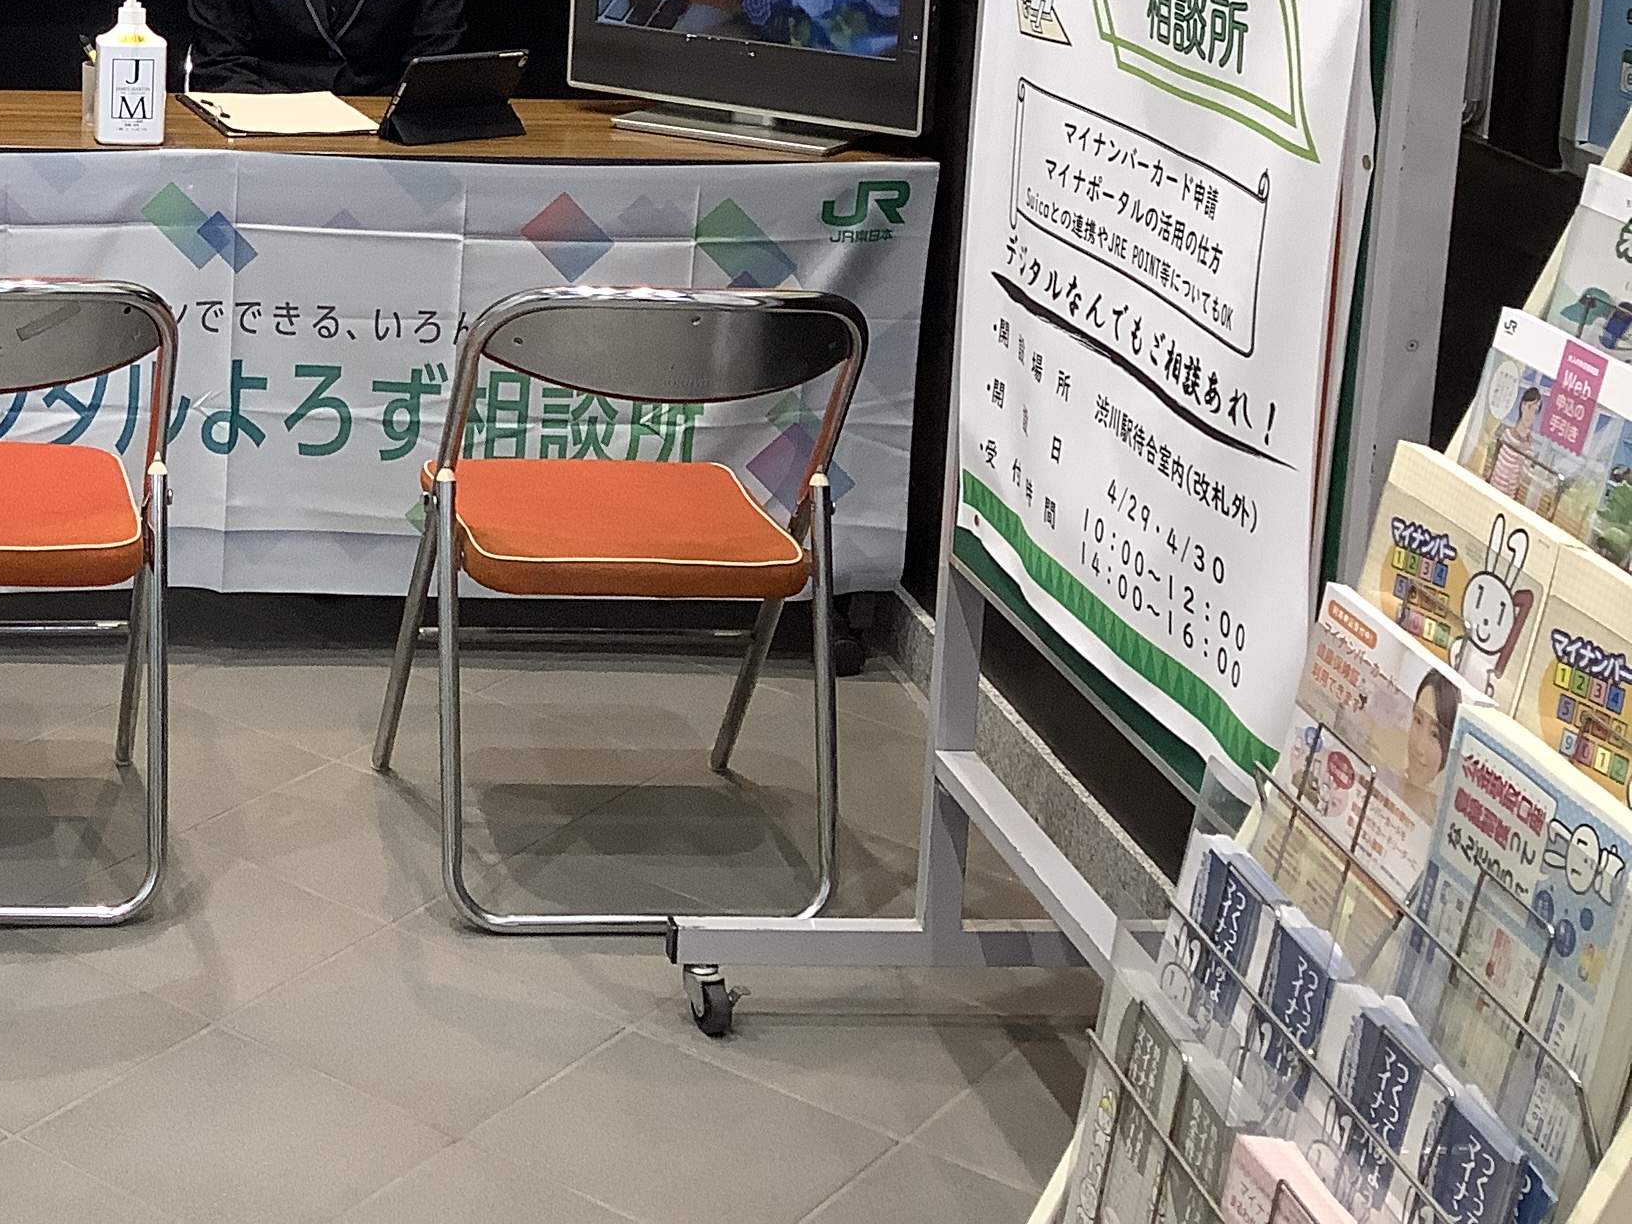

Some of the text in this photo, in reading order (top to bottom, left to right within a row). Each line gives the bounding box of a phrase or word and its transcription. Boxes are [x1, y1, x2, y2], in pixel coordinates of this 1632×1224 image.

[117, 95, 148, 119] M
[1064, 122, 1220, 221] マイナンバーカード申請
[821, 181, 911, 227] JR
[1045, 158, 1224, 275] マイナポータルの活用の仕方
[1025, 187, 1234, 332] Suicaとの連携やJRE POINT等についてもOK
[1555, 394, 1585, 421] 申込の
[1562, 369, 1592, 400] Web
[1549, 414, 1579, 443] 手引き
[1094, 393, 1258, 534] 渋川駅待合室内(改札外)
[1391, 516, 1457, 561] マイナンバー
[1551, 628, 1632, 683] マイナンバー
